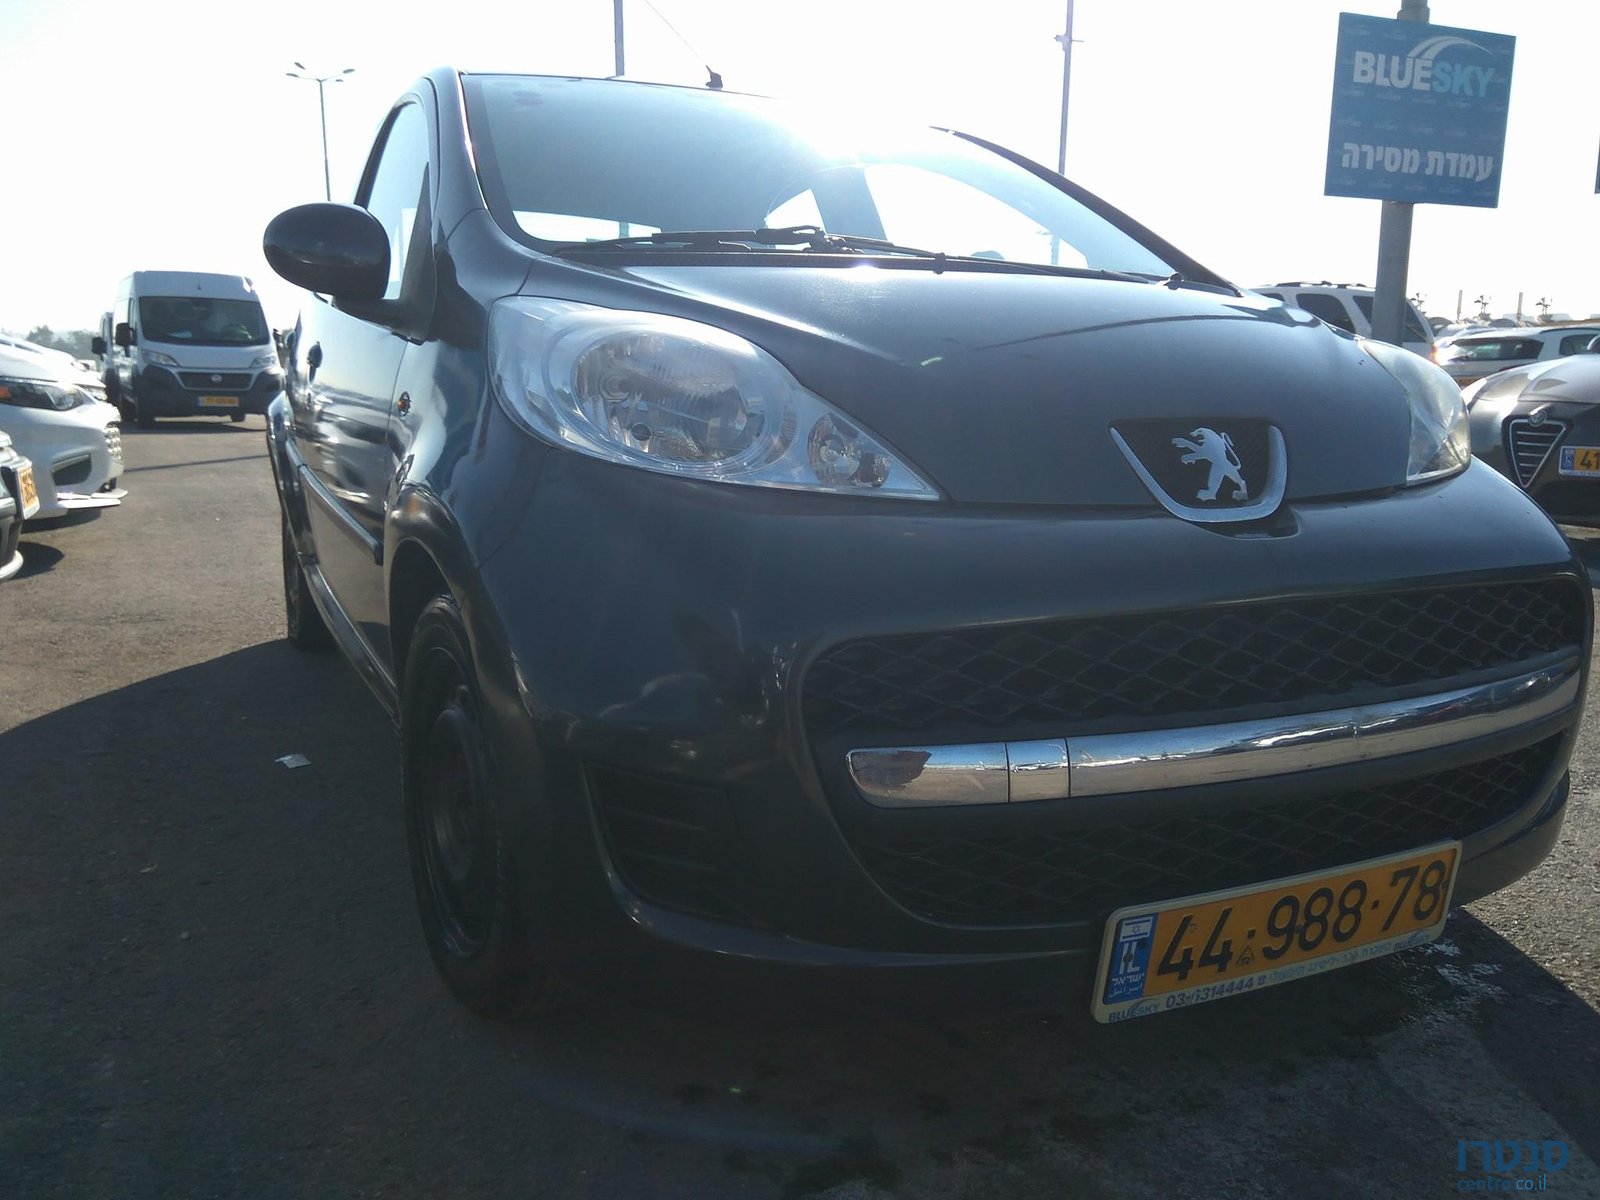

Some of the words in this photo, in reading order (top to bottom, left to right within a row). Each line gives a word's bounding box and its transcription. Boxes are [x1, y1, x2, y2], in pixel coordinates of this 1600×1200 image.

[1353, 51, 1496, 97] BLUESKY
[1341, 142, 1420, 174] מסירה
[1425, 150, 1494, 183] עמדת
[1112, 972, 1145, 986] ישראל
